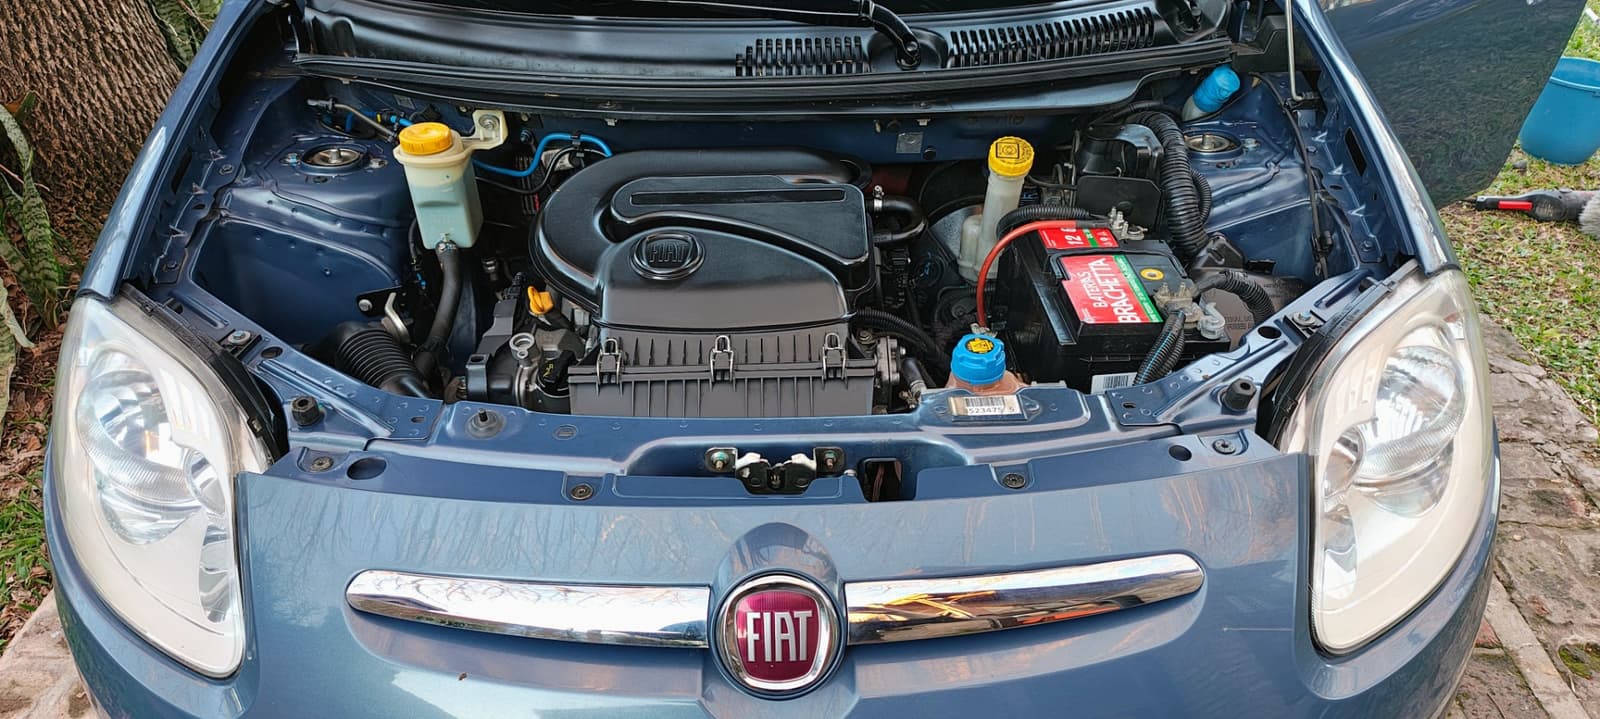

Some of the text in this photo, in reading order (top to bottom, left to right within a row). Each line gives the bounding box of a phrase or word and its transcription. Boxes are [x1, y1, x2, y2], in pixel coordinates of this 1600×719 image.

[647, 242, 689, 262] FIAT
[1088, 257, 1141, 323] BRACHETTA
[746, 610, 813, 662] FIAT
